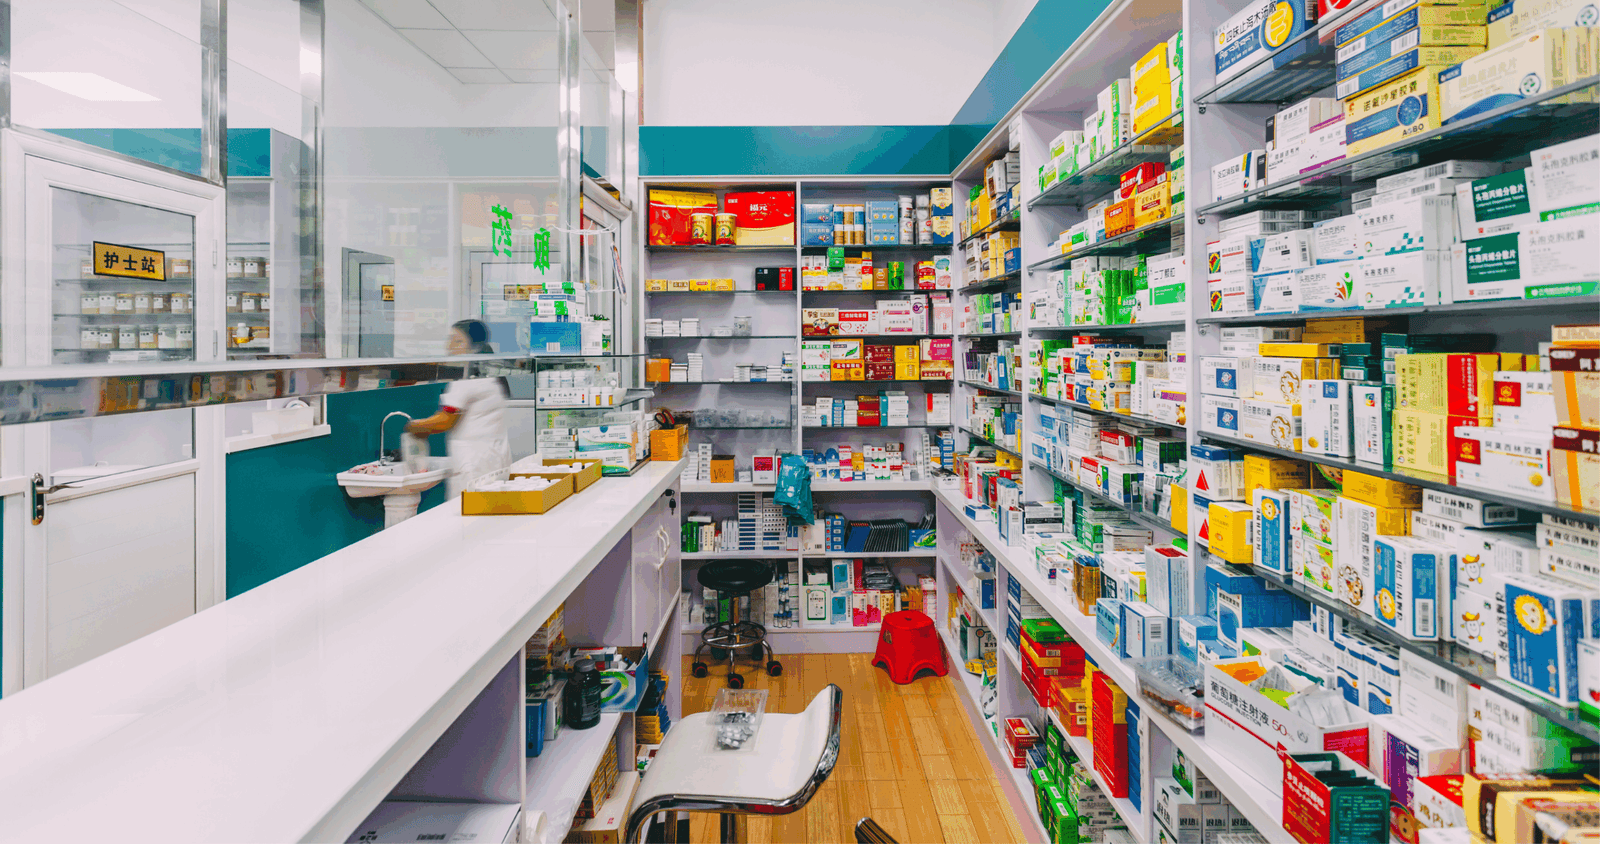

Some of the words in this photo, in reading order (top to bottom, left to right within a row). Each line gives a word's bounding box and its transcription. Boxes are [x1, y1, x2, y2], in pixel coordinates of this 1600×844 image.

[1363, 80, 1417, 112] 诺氟沙星胶囊
[103, 252, 156, 273] 护士站
[1485, 440, 1543, 456] 阿莫西林胶囊
[1210, 680, 1270, 726] 葡萄糖注射液
[1211, 692, 1234, 709] GLUCOSE
[1235, 707, 1262, 727] INJECTION
